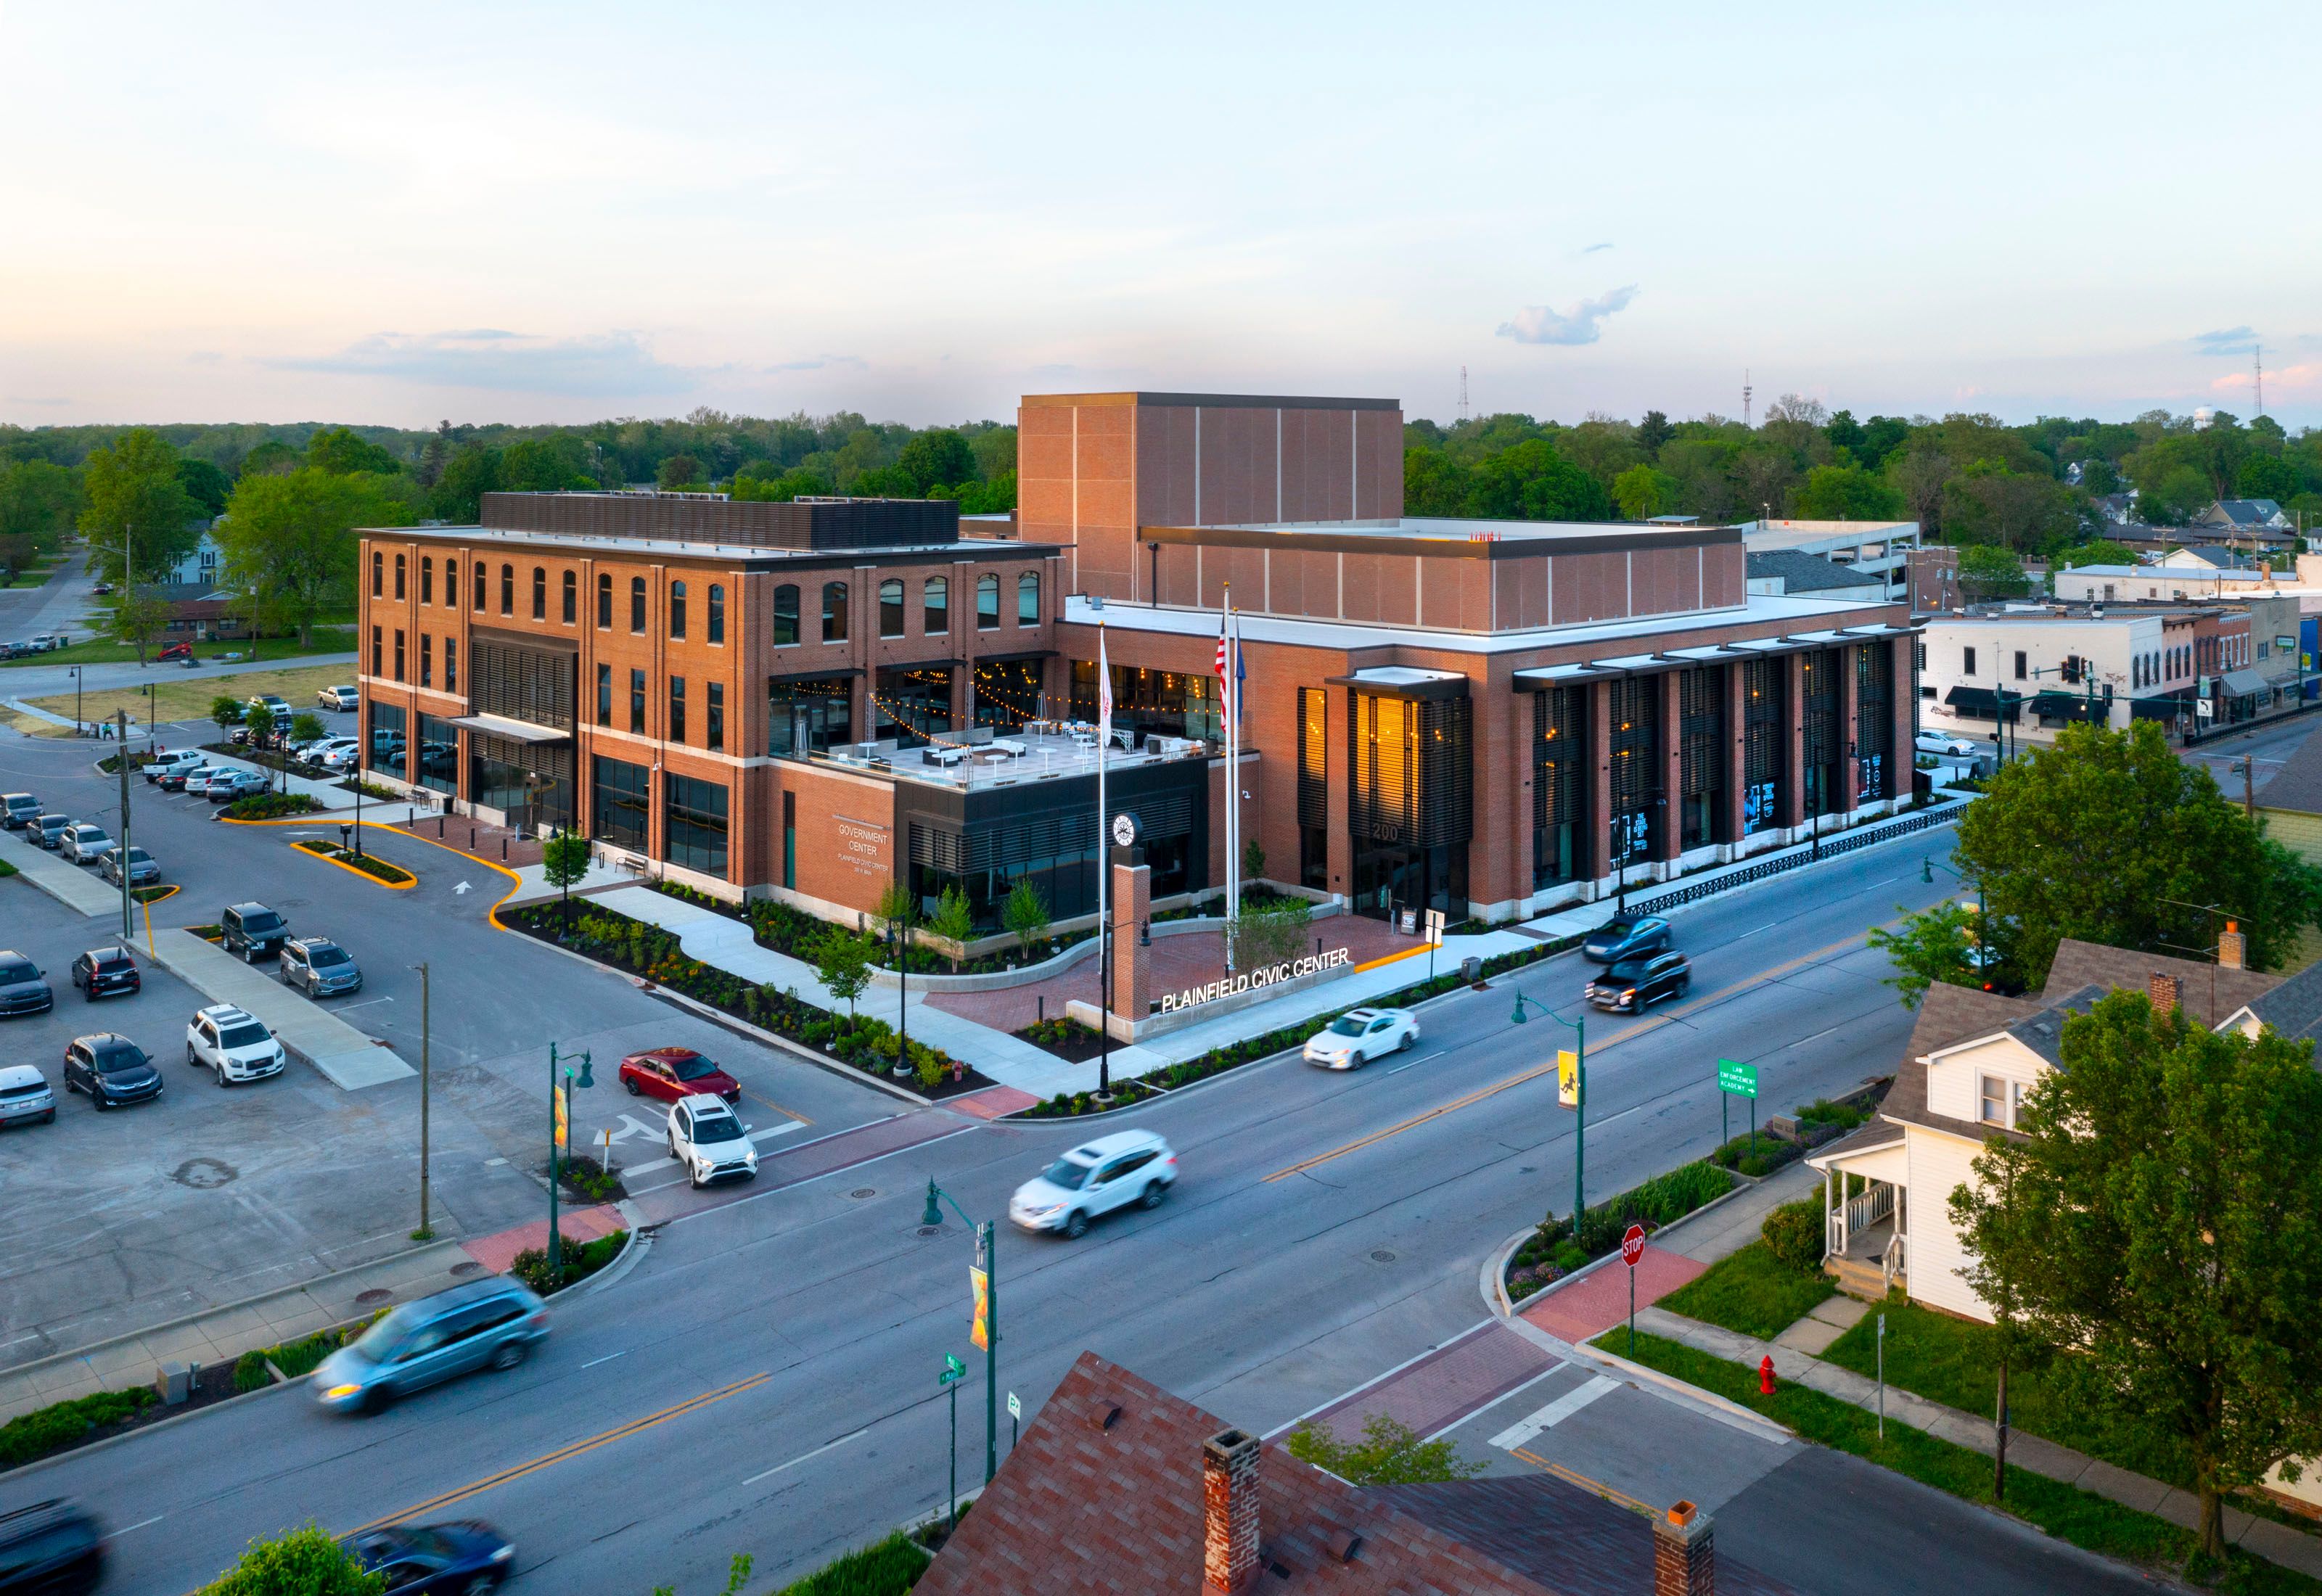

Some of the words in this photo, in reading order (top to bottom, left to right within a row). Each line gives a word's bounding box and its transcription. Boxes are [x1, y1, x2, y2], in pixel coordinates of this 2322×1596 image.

[839, 824, 887, 845] GOVERNMENT
[1373, 823, 1398, 842] 200
[849, 840, 877, 856] CENTER
[838, 853, 860, 864] PLAINFIELD
[861, 859, 871, 868] CIVIC
[871, 862, 889, 871] CENTER
[1162, 974, 1248, 1014] PLAINFIELD
[1252, 963, 1289, 989] CIVIC
[1293, 947, 1348, 977] CENTER
[1720, 1071, 1755, 1085] ENFORCEMENT
[1720, 1080, 1744, 1091] ACADEMY
[1624, 1235, 1644, 1256] STOP
